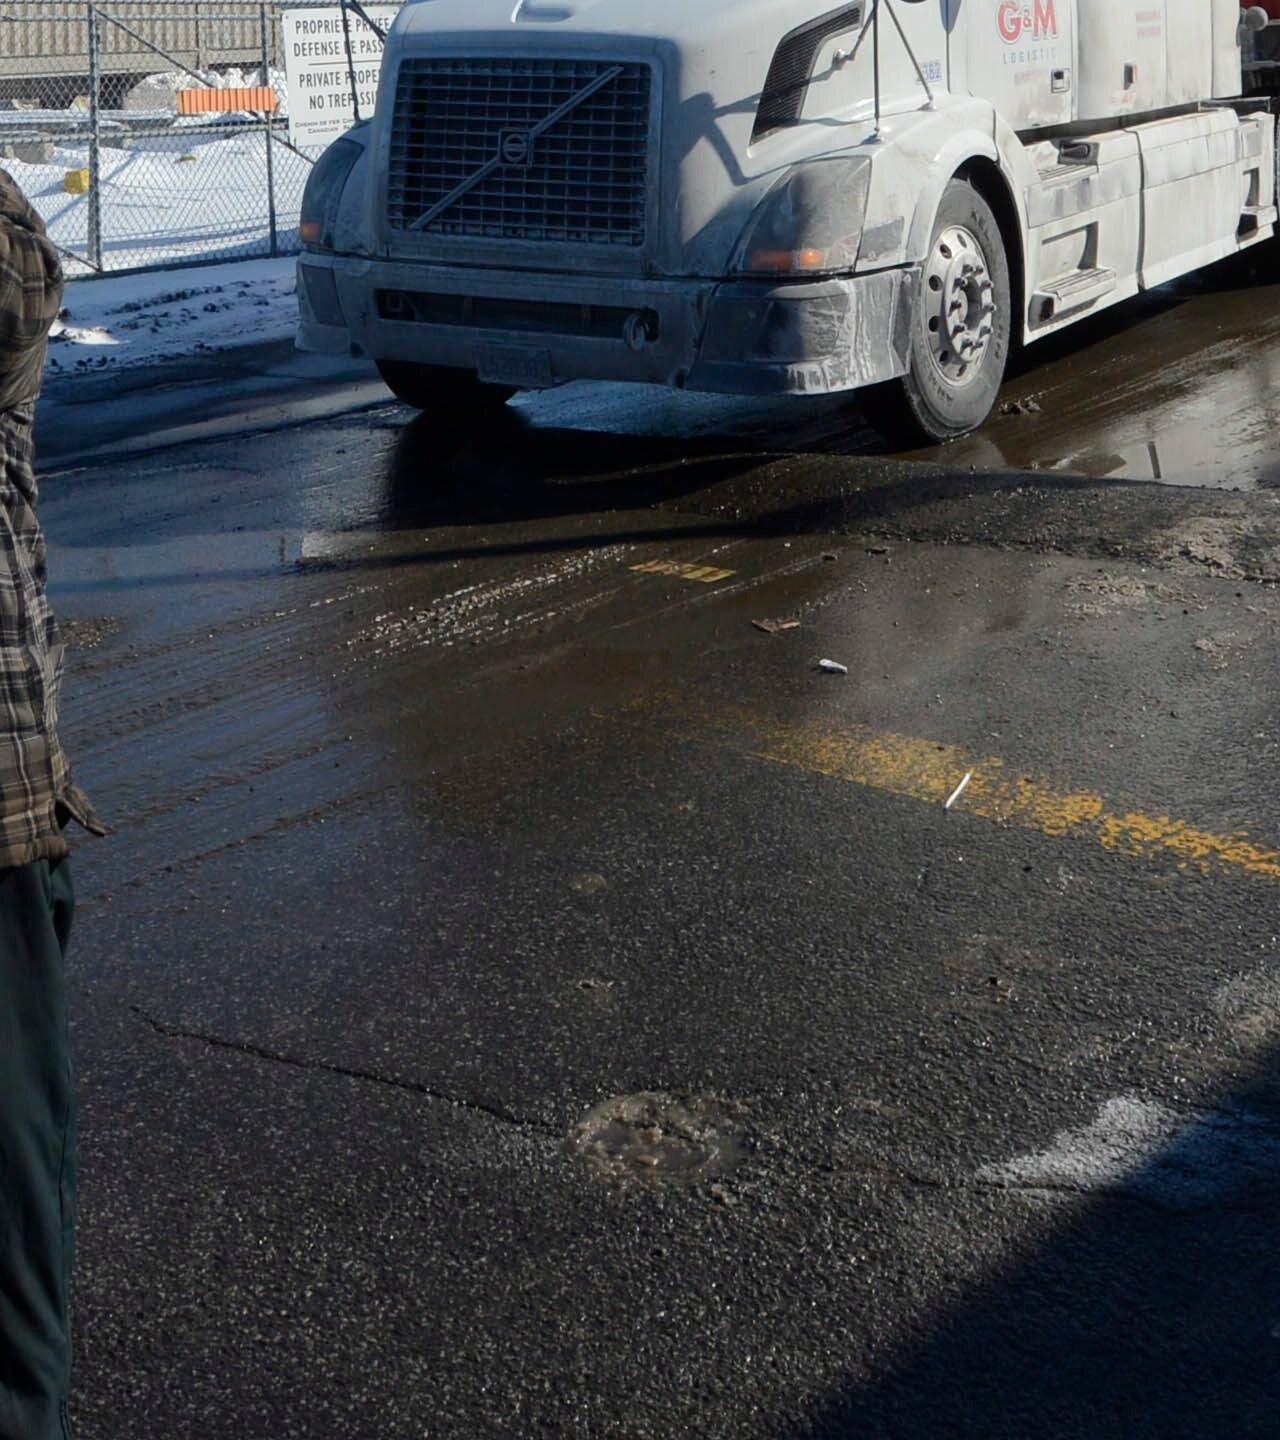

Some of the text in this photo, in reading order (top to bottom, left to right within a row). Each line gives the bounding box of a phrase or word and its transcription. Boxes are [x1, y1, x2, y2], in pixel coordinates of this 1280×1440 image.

[295, 13, 390, 34] PROPRIÉÉ PRVÉE
[293, 38, 340, 57] DÉFENSE
[344, 40, 357, 55] E
[299, 71, 341, 88] PRIVATE
[309, 95, 325, 110] NO
